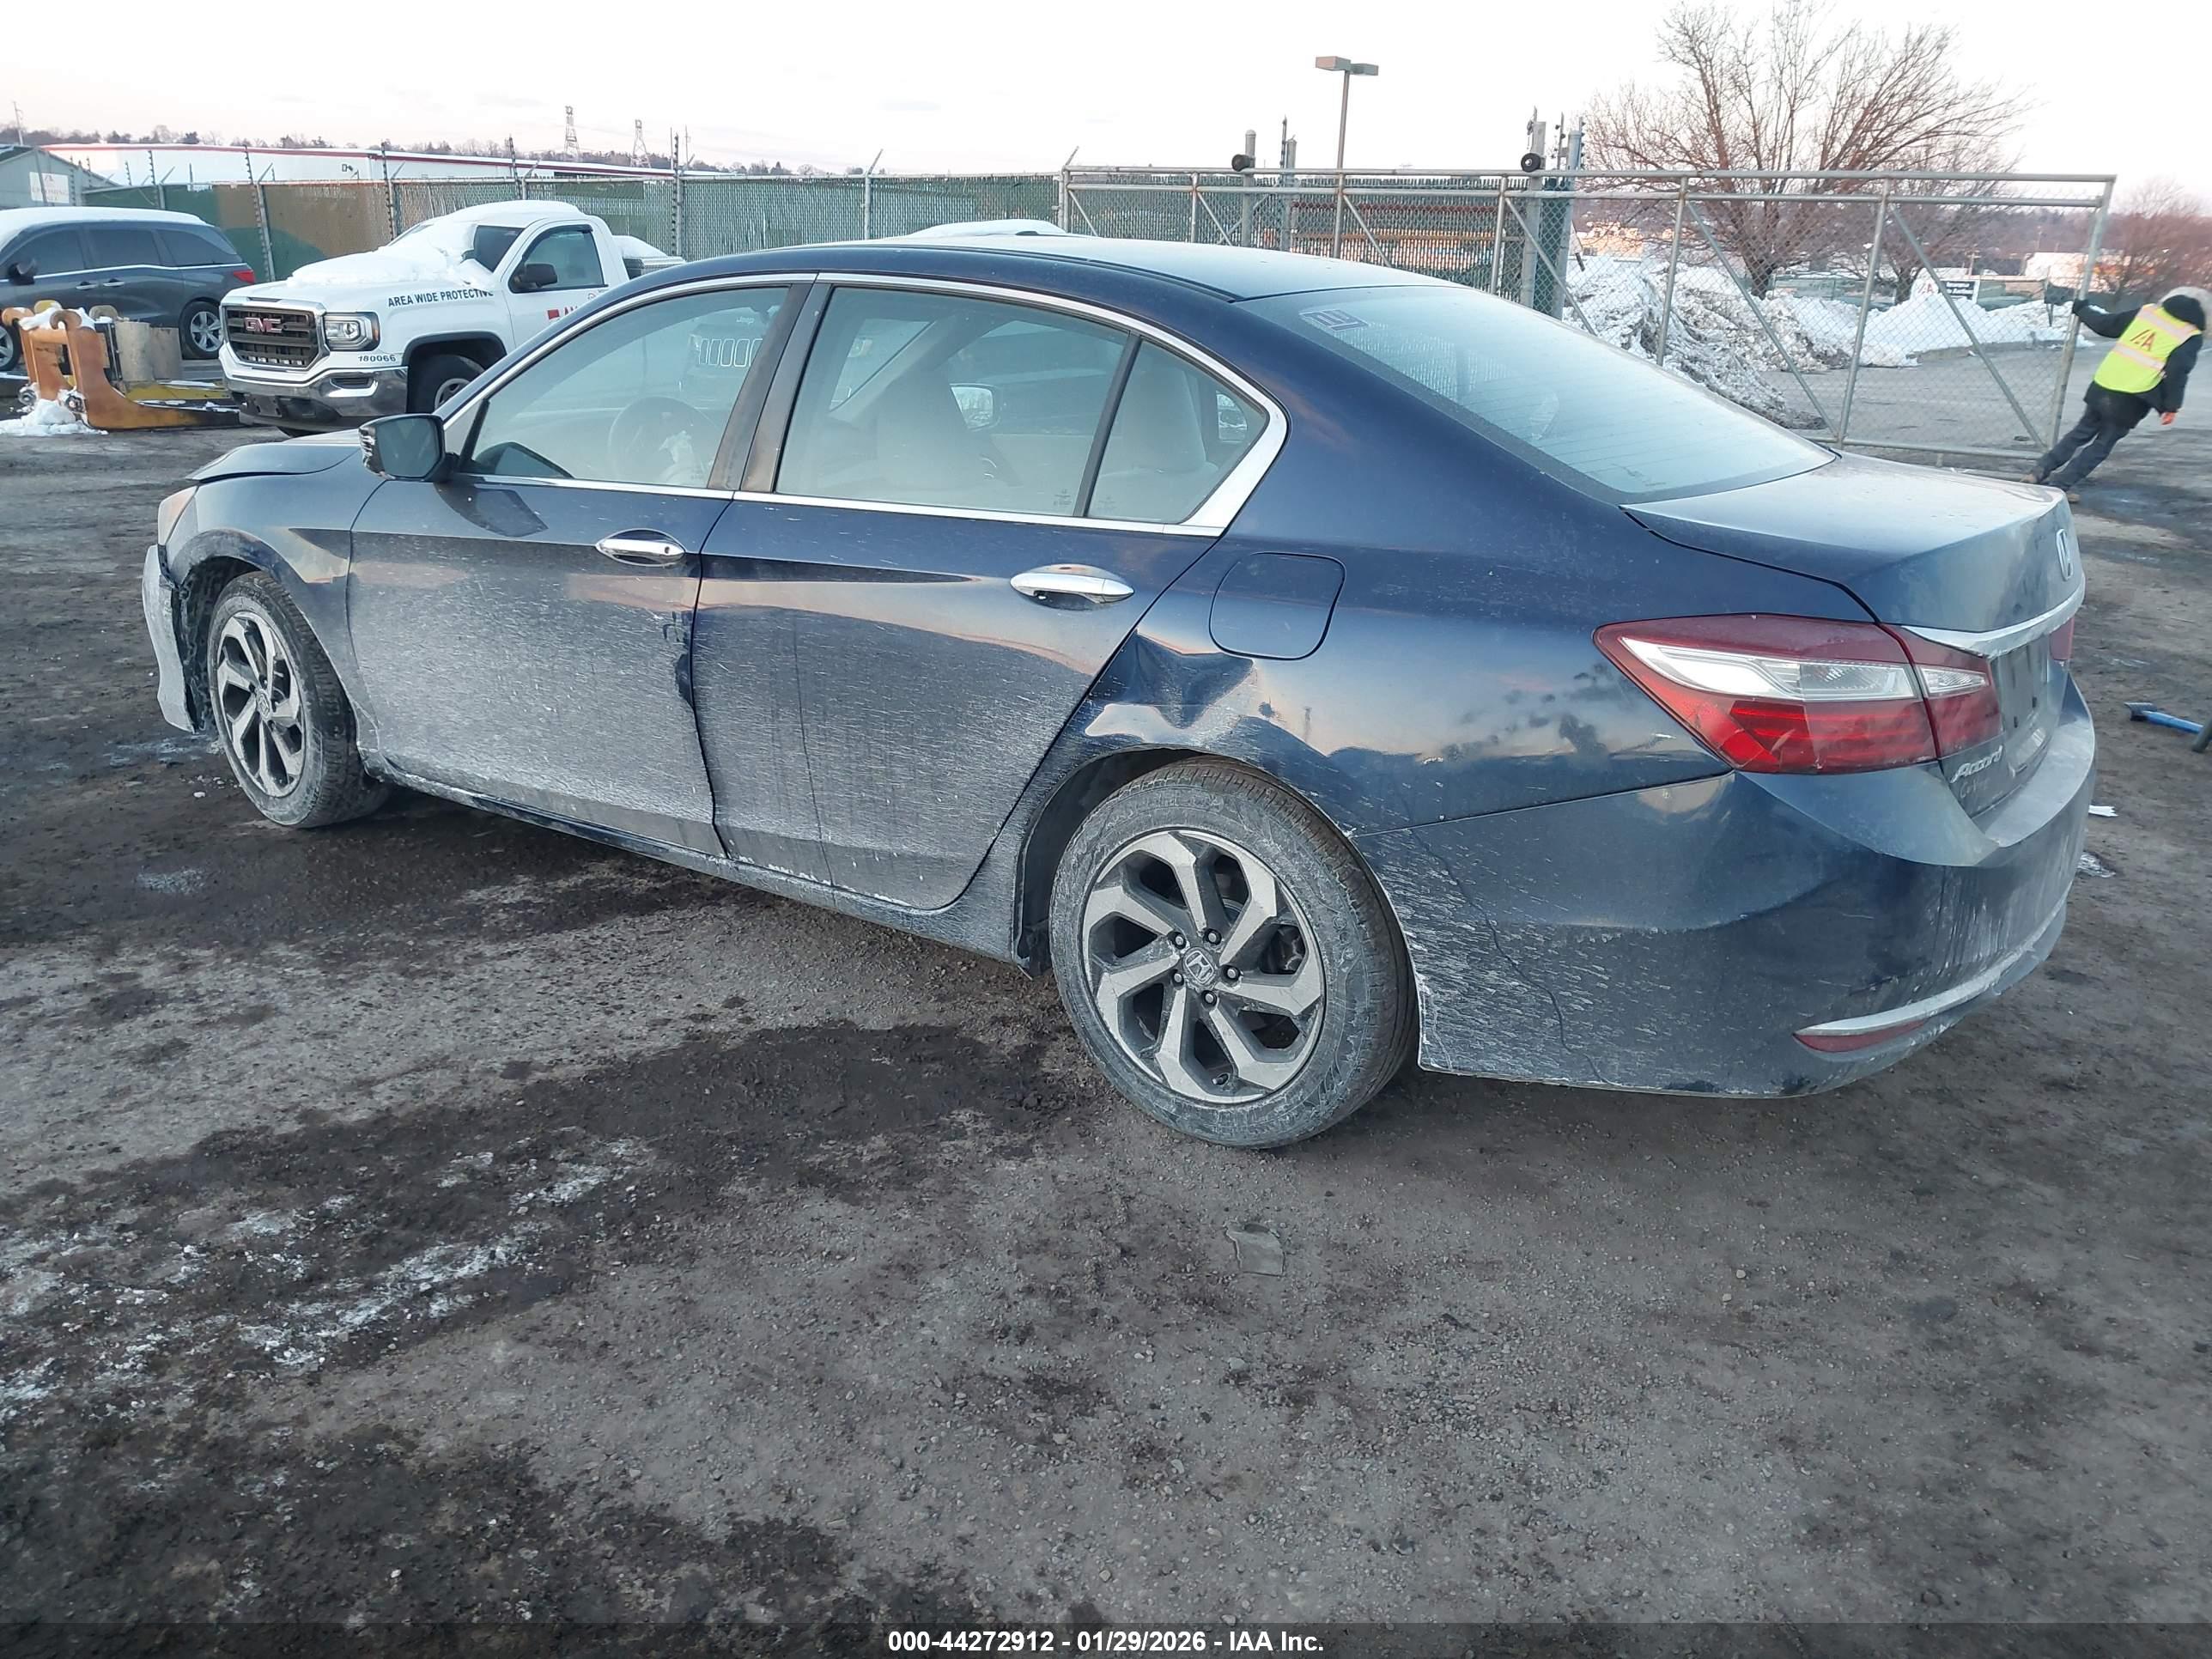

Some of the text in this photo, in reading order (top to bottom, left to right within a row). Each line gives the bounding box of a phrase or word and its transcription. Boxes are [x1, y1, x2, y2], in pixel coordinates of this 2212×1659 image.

[388, 295, 413, 307] AREA
[414, 292, 439, 303] WIDE
[245, 317, 283, 333] GMC
[1950, 744, 2003, 783] Accord
